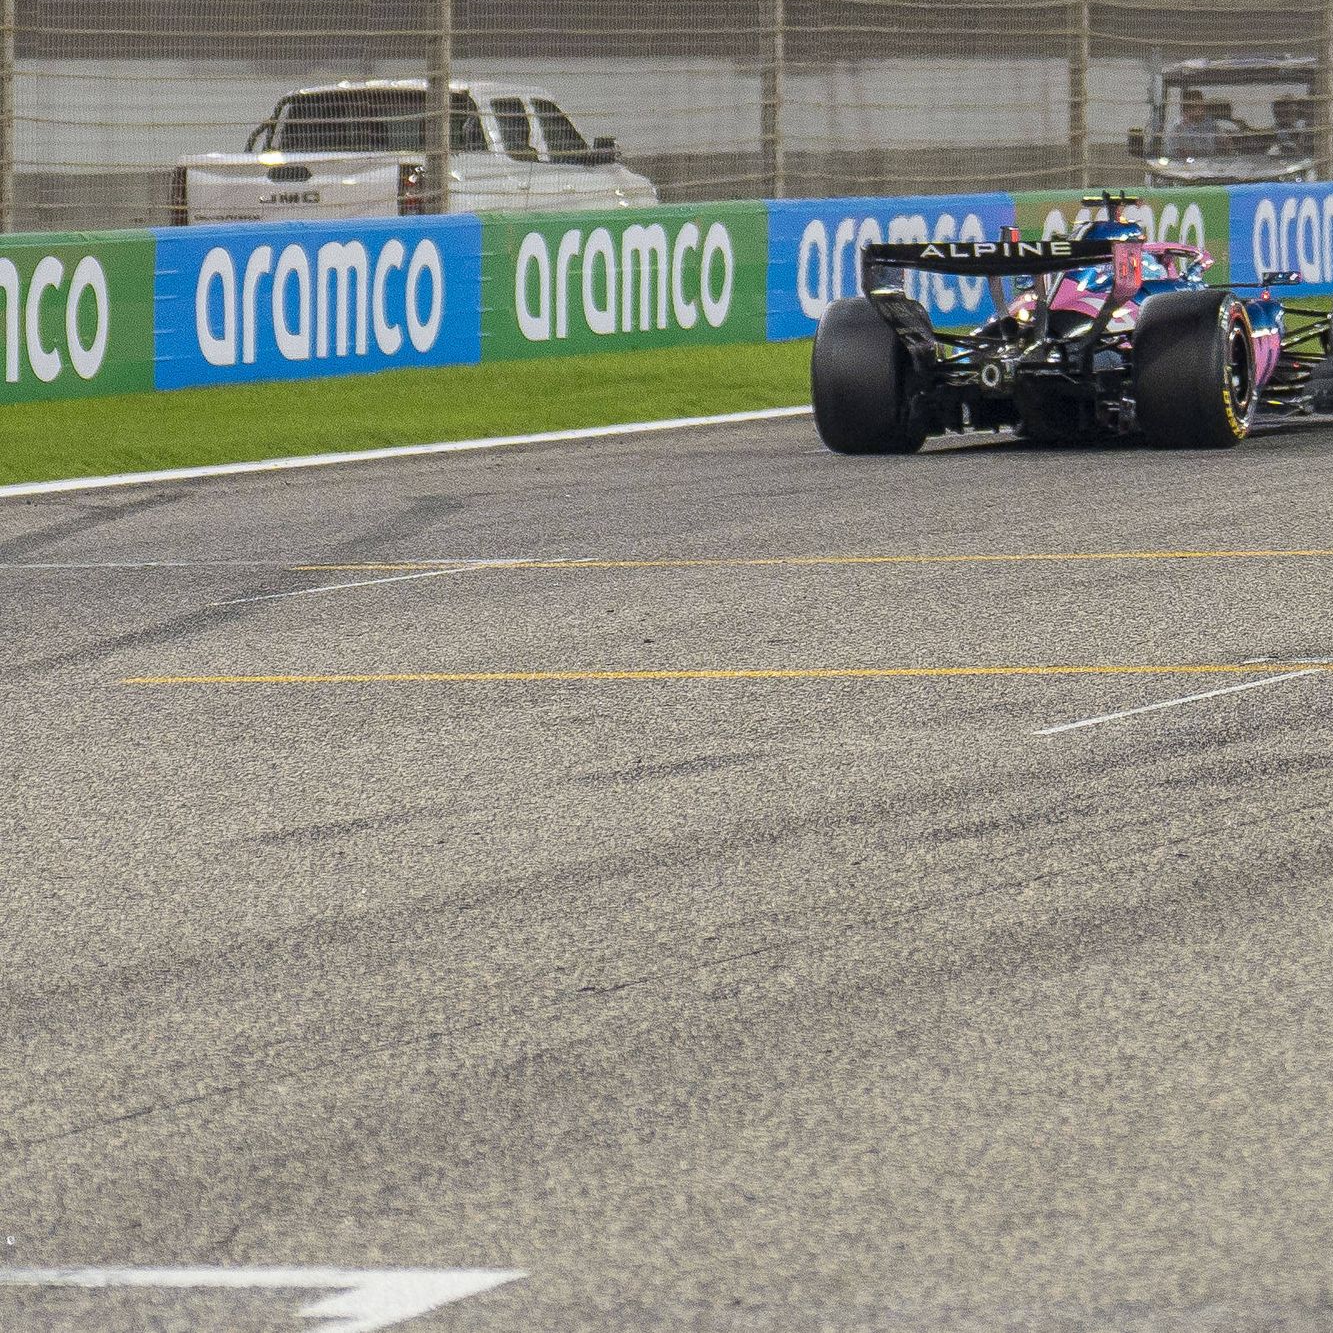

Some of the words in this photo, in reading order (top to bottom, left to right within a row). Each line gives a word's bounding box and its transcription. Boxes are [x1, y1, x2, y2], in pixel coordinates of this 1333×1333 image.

[196, 239, 444, 366] aramco
[515, 222, 734, 341] aramco
[919, 241, 1073, 259] ALPINE
